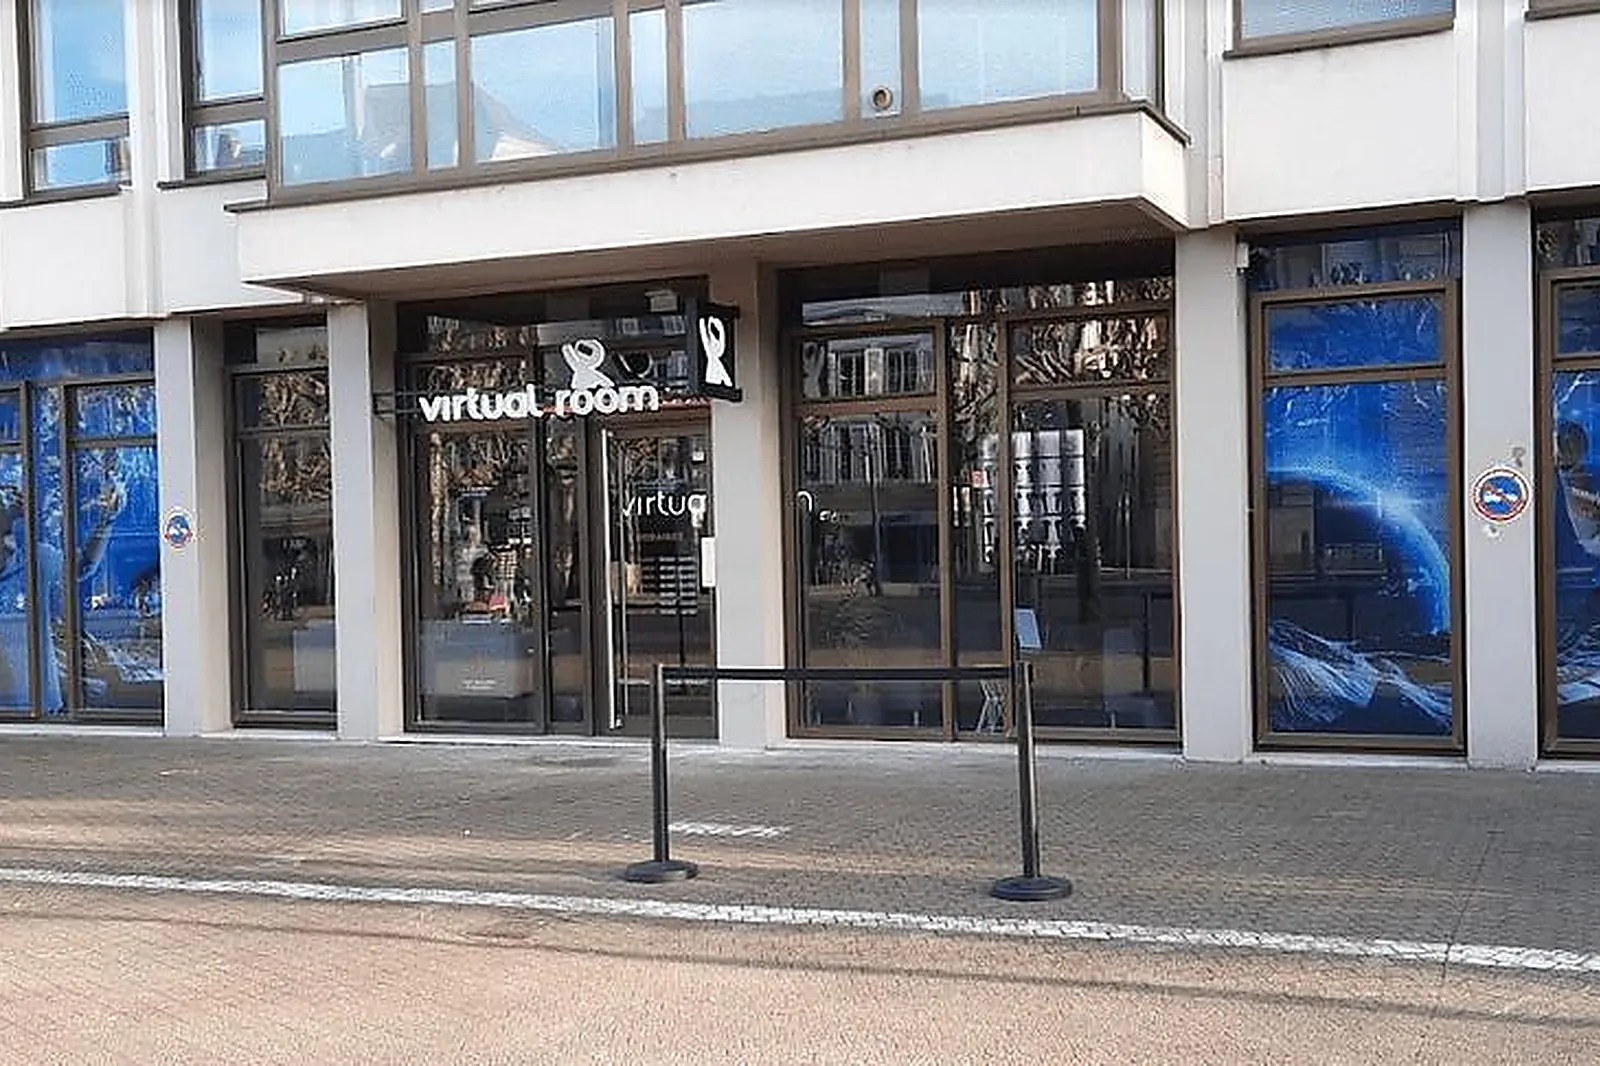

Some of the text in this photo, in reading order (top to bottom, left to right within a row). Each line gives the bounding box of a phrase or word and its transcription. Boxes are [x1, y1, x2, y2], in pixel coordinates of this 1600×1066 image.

[419, 384, 659, 421] virtual room
[622, 491, 707, 516] virtua
